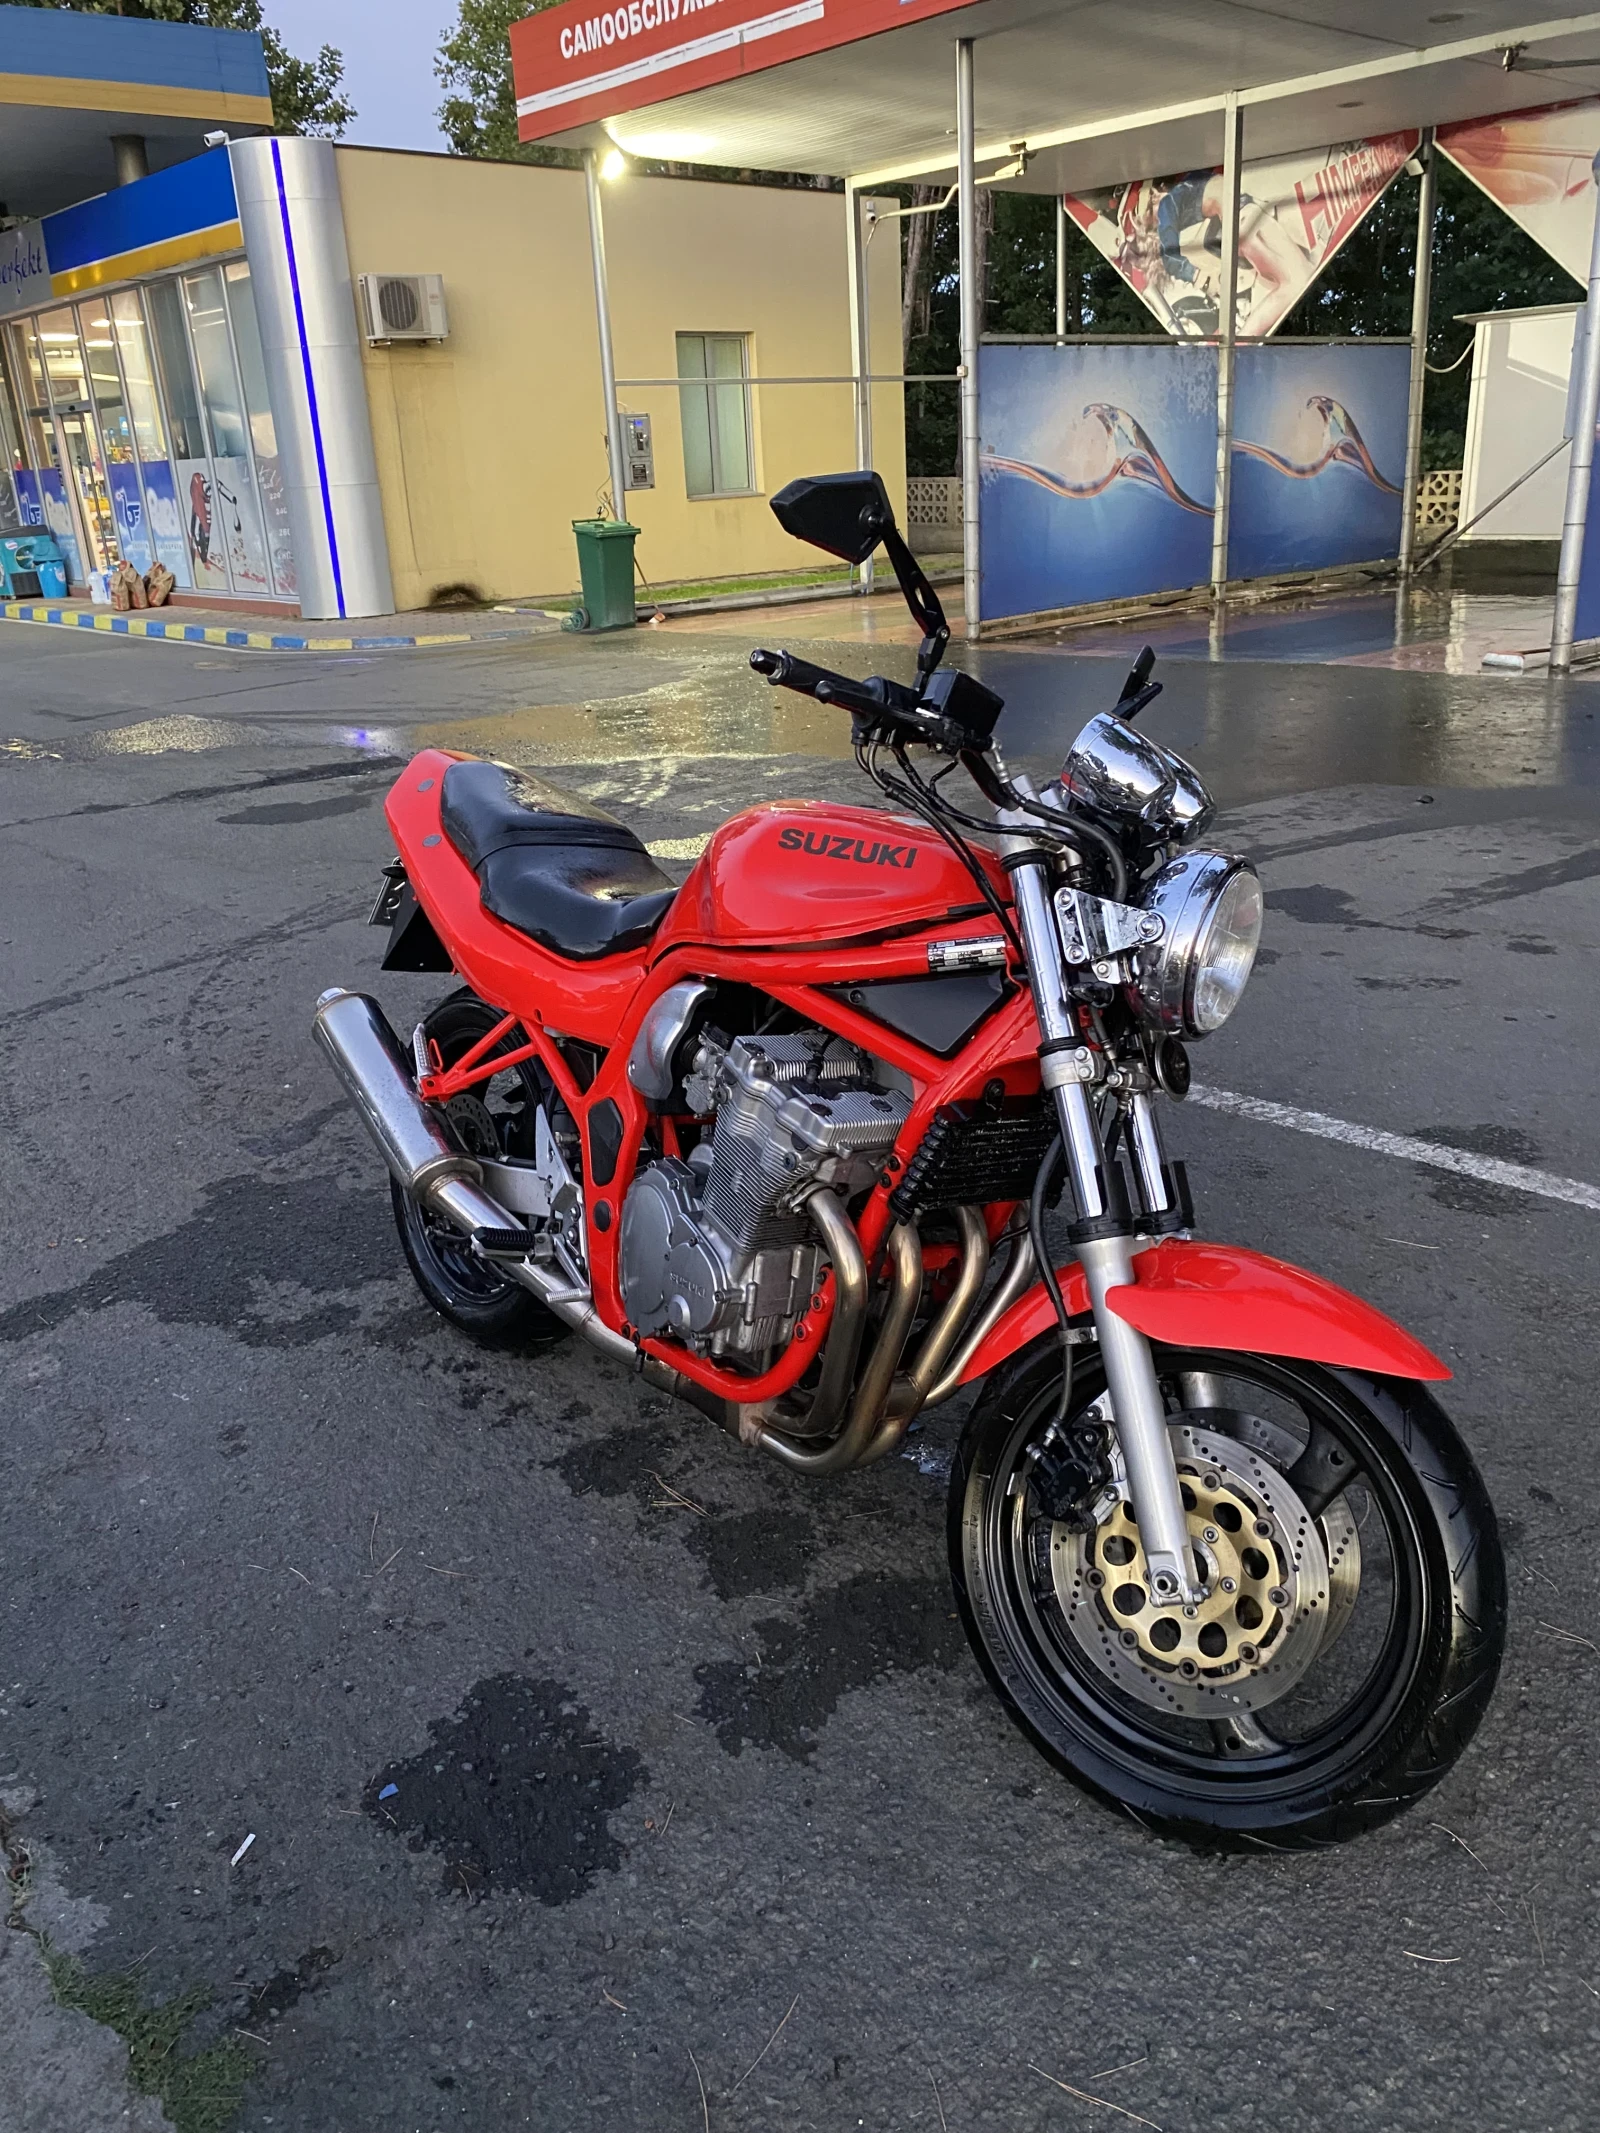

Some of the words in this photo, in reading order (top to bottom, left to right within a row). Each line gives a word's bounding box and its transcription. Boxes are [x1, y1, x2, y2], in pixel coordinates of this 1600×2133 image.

[560, 0, 724, 59] САМООБСЛУ
[0, 241, 43, 294] erfekt
[778, 828, 918, 869] SUZUKI
